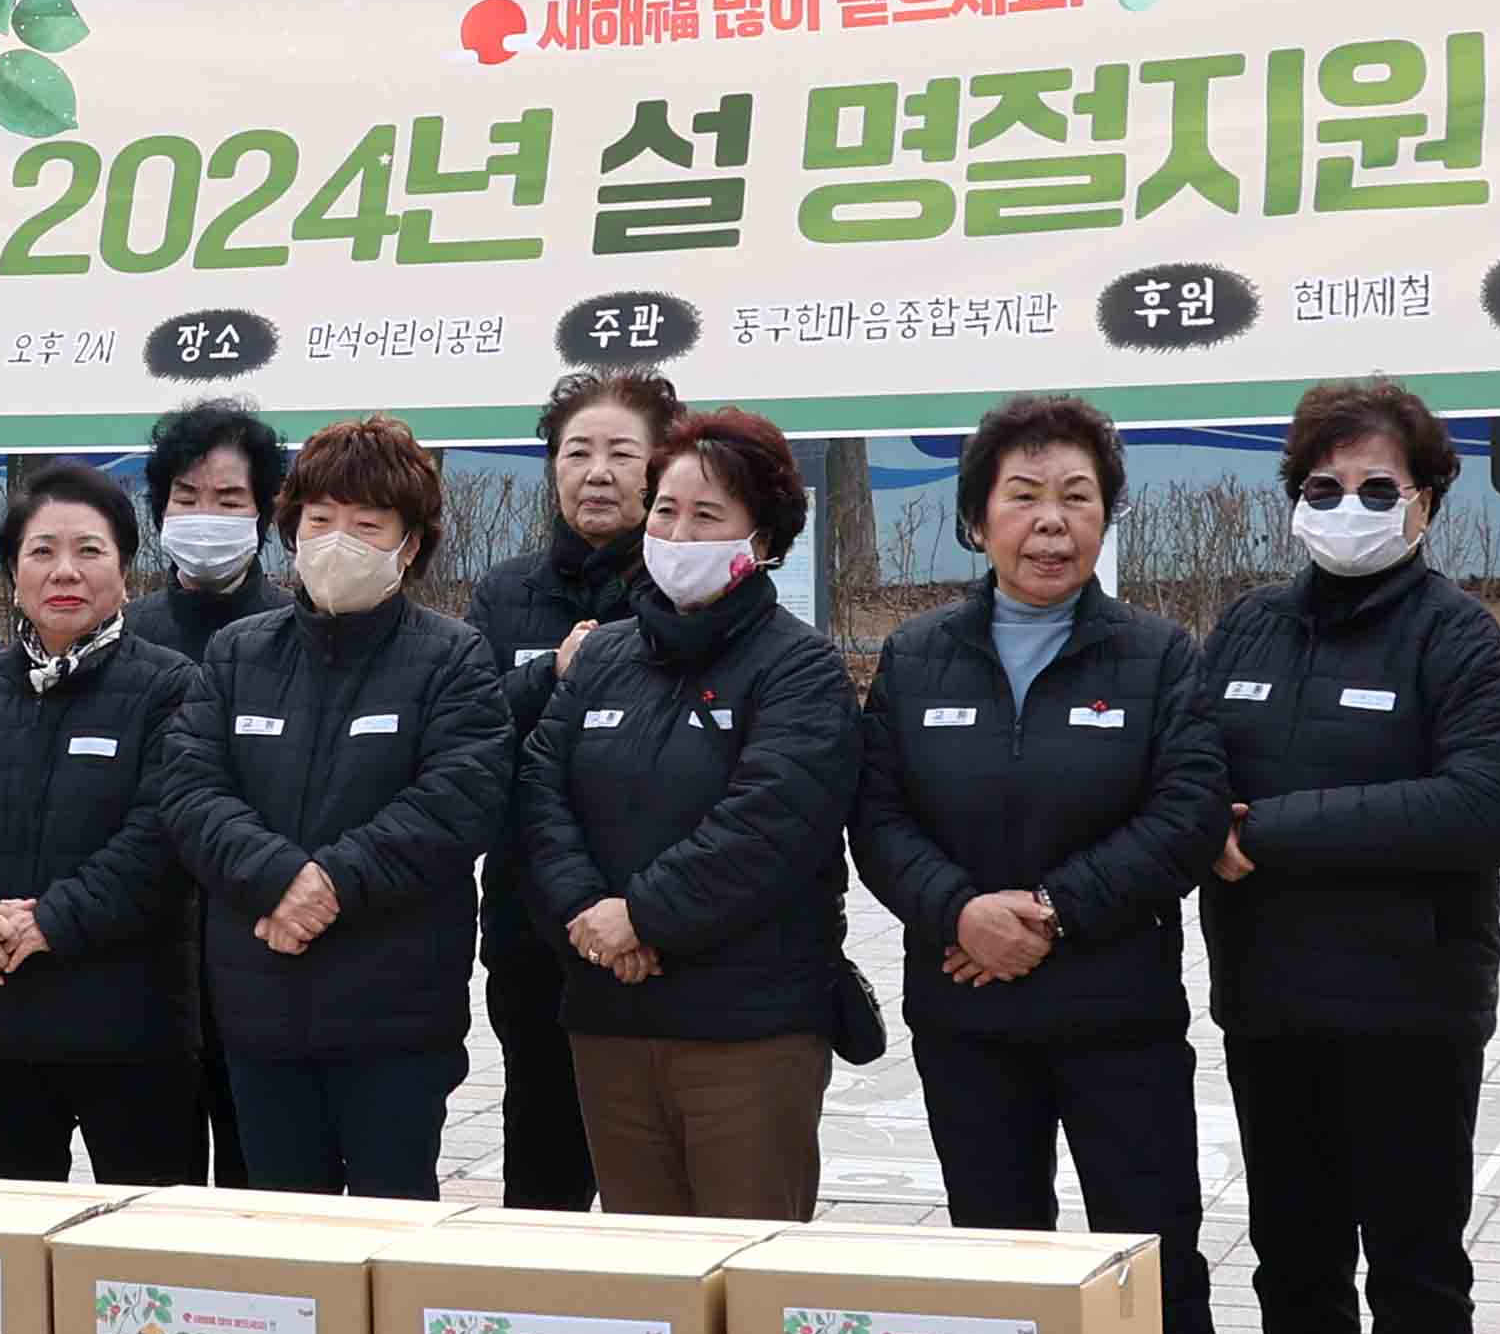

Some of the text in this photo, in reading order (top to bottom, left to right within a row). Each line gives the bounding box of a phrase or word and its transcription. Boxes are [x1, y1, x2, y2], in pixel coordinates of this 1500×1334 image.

[592, 93, 753, 255] 설
[797, 29, 1490, 245] 명절지원
[7, 328, 63, 368] 오후
[72, 327, 116, 366] 2시
[176, 322, 243, 363] 장소
[304, 315, 504, 361] 만석어린이공원
[588, 304, 666, 350] 주관
[732, 293, 1058, 344] 동구한마음종합복지관
[1132, 278, 1218, 329] 후원
[1292, 273, 1433, 324] 현대제철
